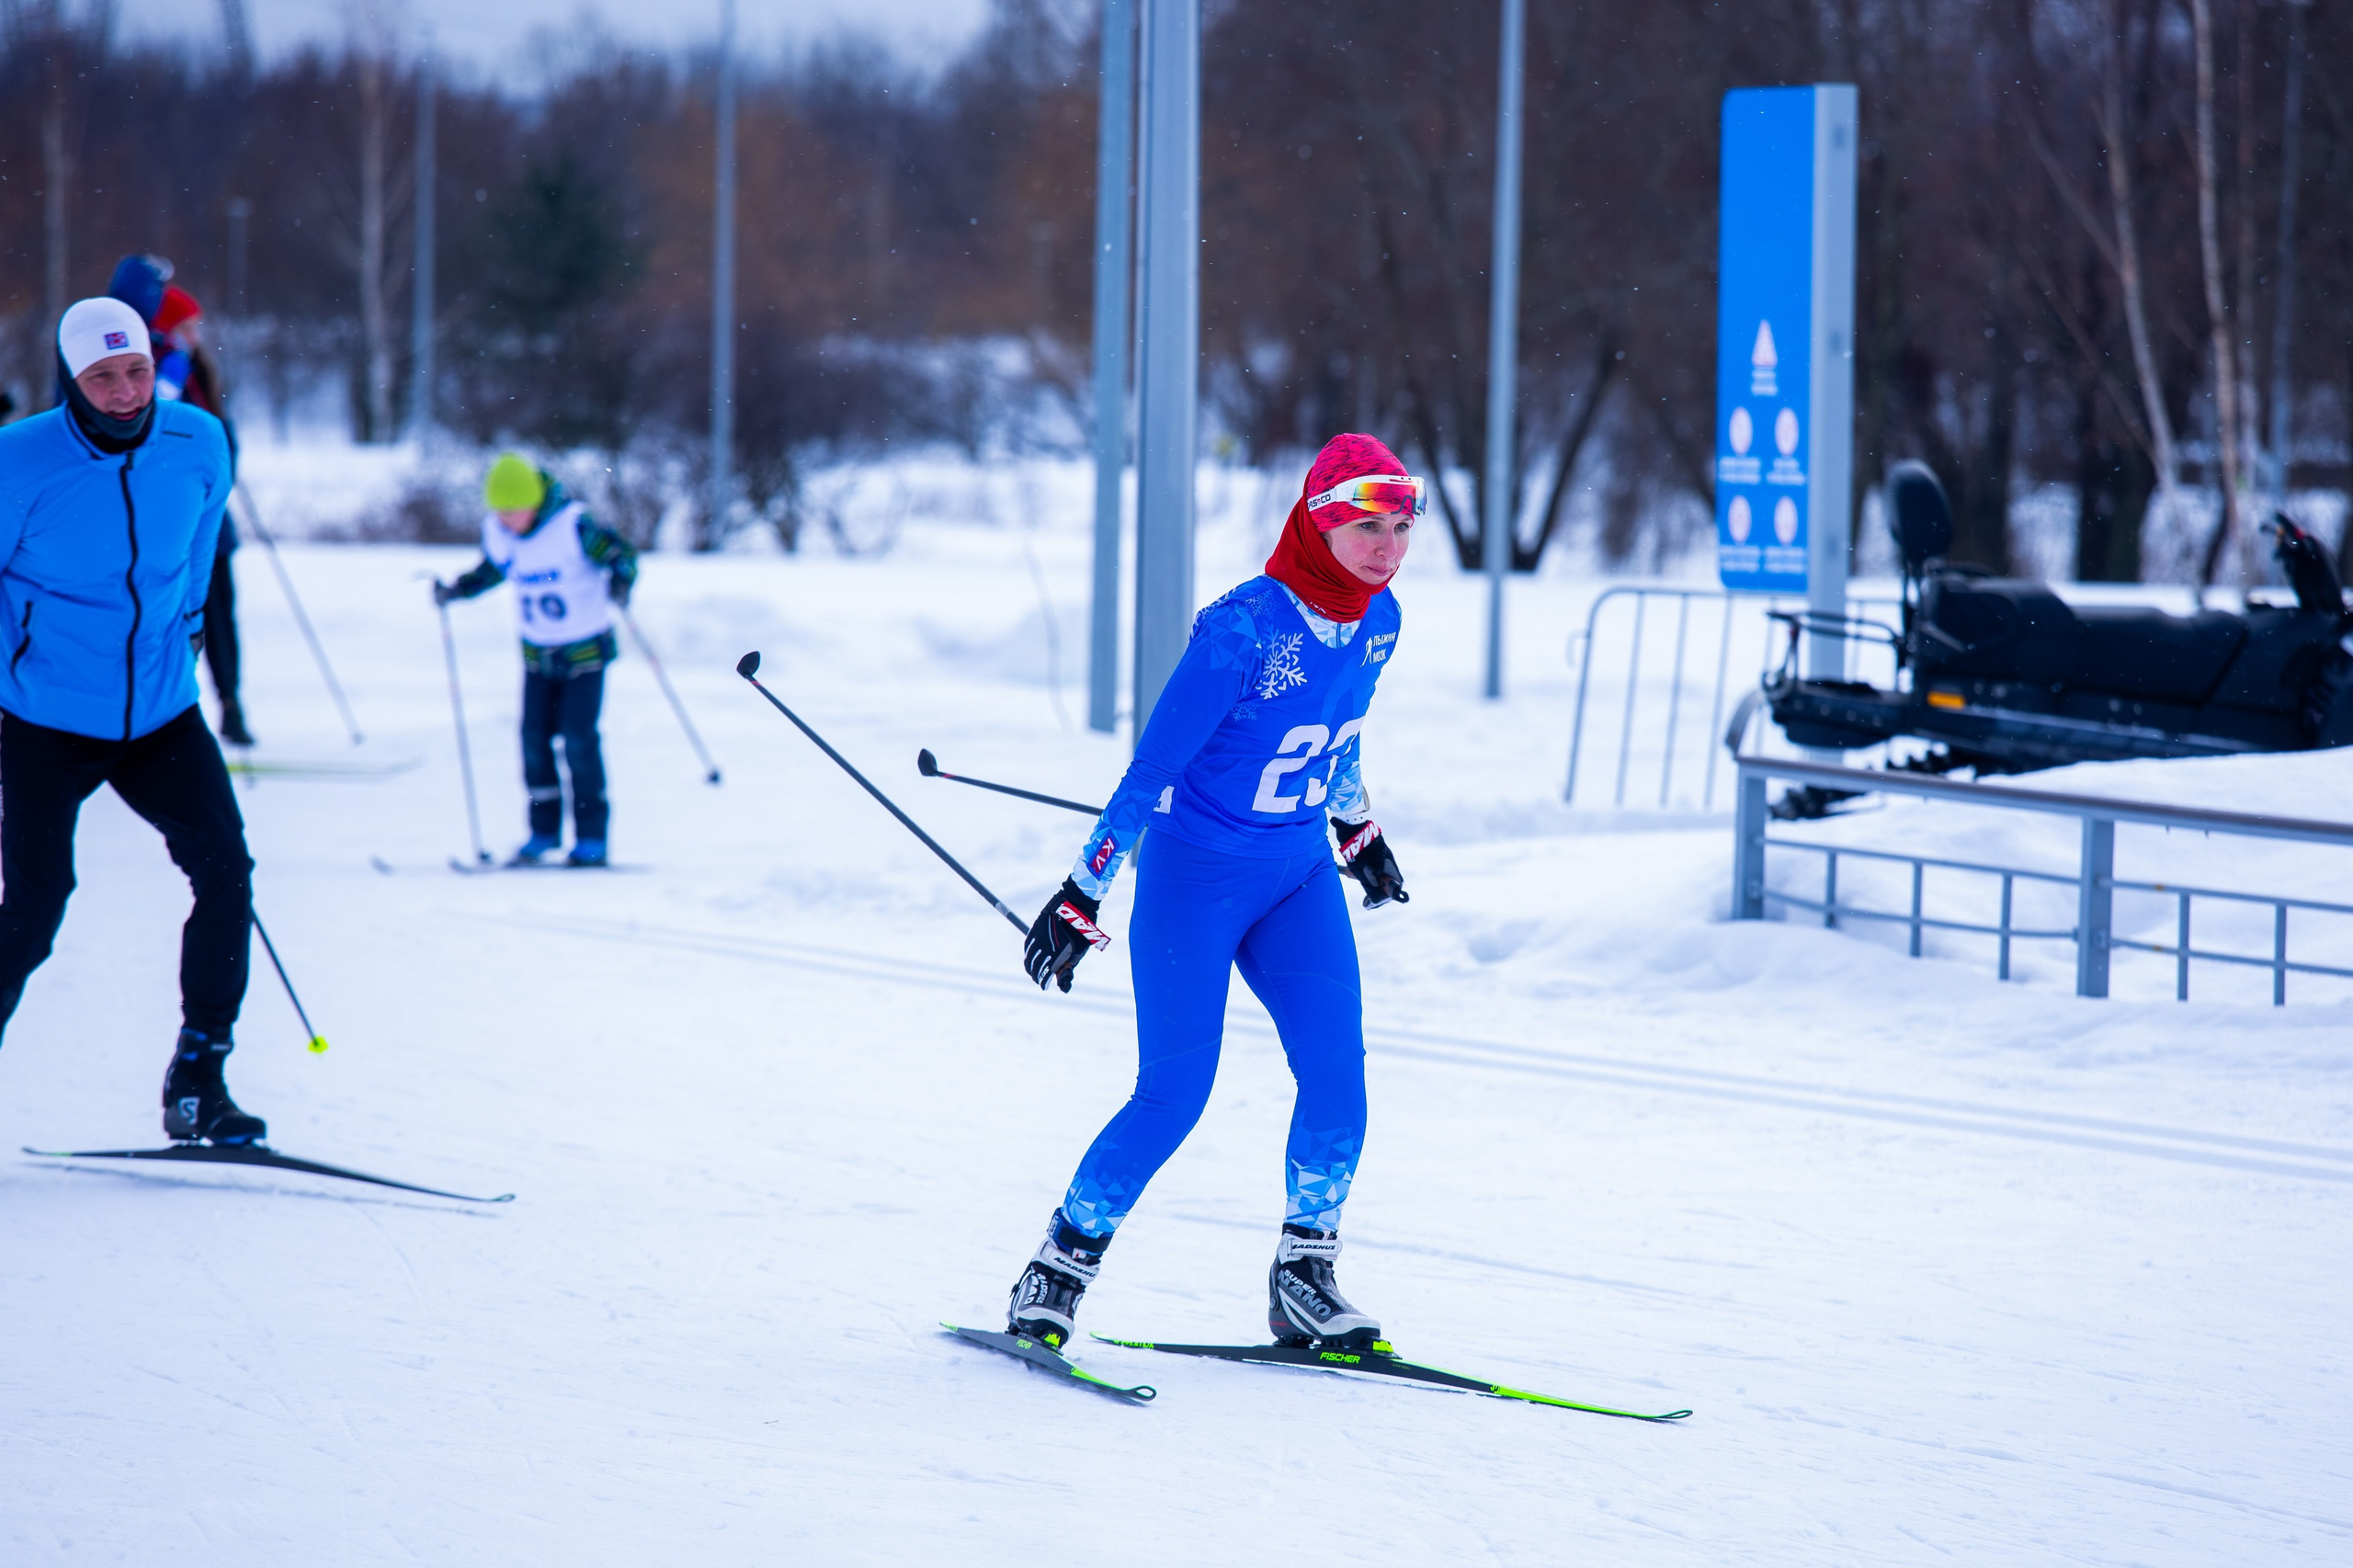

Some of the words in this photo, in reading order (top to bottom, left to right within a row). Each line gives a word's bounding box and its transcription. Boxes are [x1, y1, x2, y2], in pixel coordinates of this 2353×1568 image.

[1277, 1270, 1332, 1317] NANO
[1283, 1269, 1317, 1296] SUPER
[1319, 1351, 1361, 1365] FISCHER
